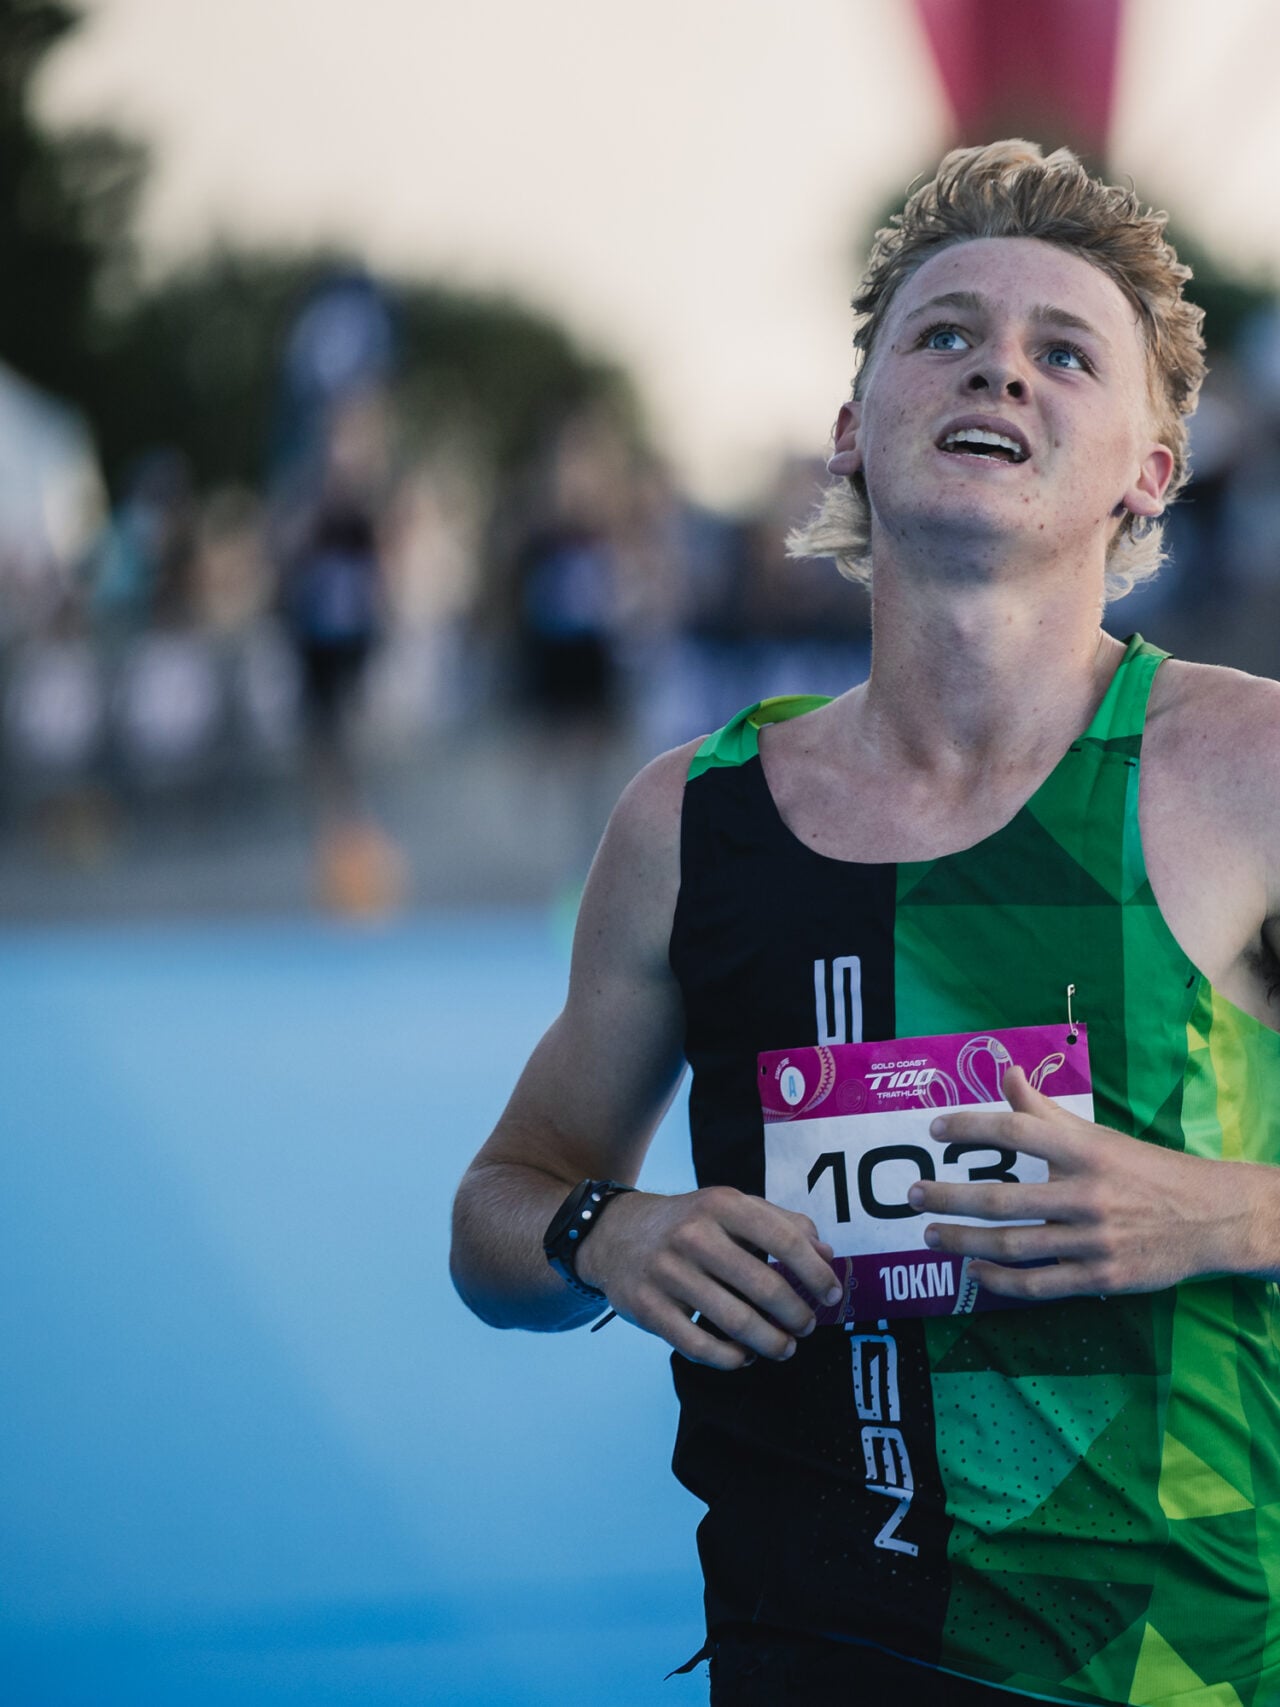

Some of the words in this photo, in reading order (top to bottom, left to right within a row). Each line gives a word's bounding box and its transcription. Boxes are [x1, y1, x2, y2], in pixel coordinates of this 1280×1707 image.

[871, 1062, 895, 1070] GOLD
[896, 1059, 927, 1068] COAST
[788, 1074, 797, 1098] A
[864, 1068, 936, 1090] T100
[876, 1088, 926, 1099] TRIATHLON
[807, 1143, 1021, 1224] 103
[879, 1261, 955, 1301] 10KM
